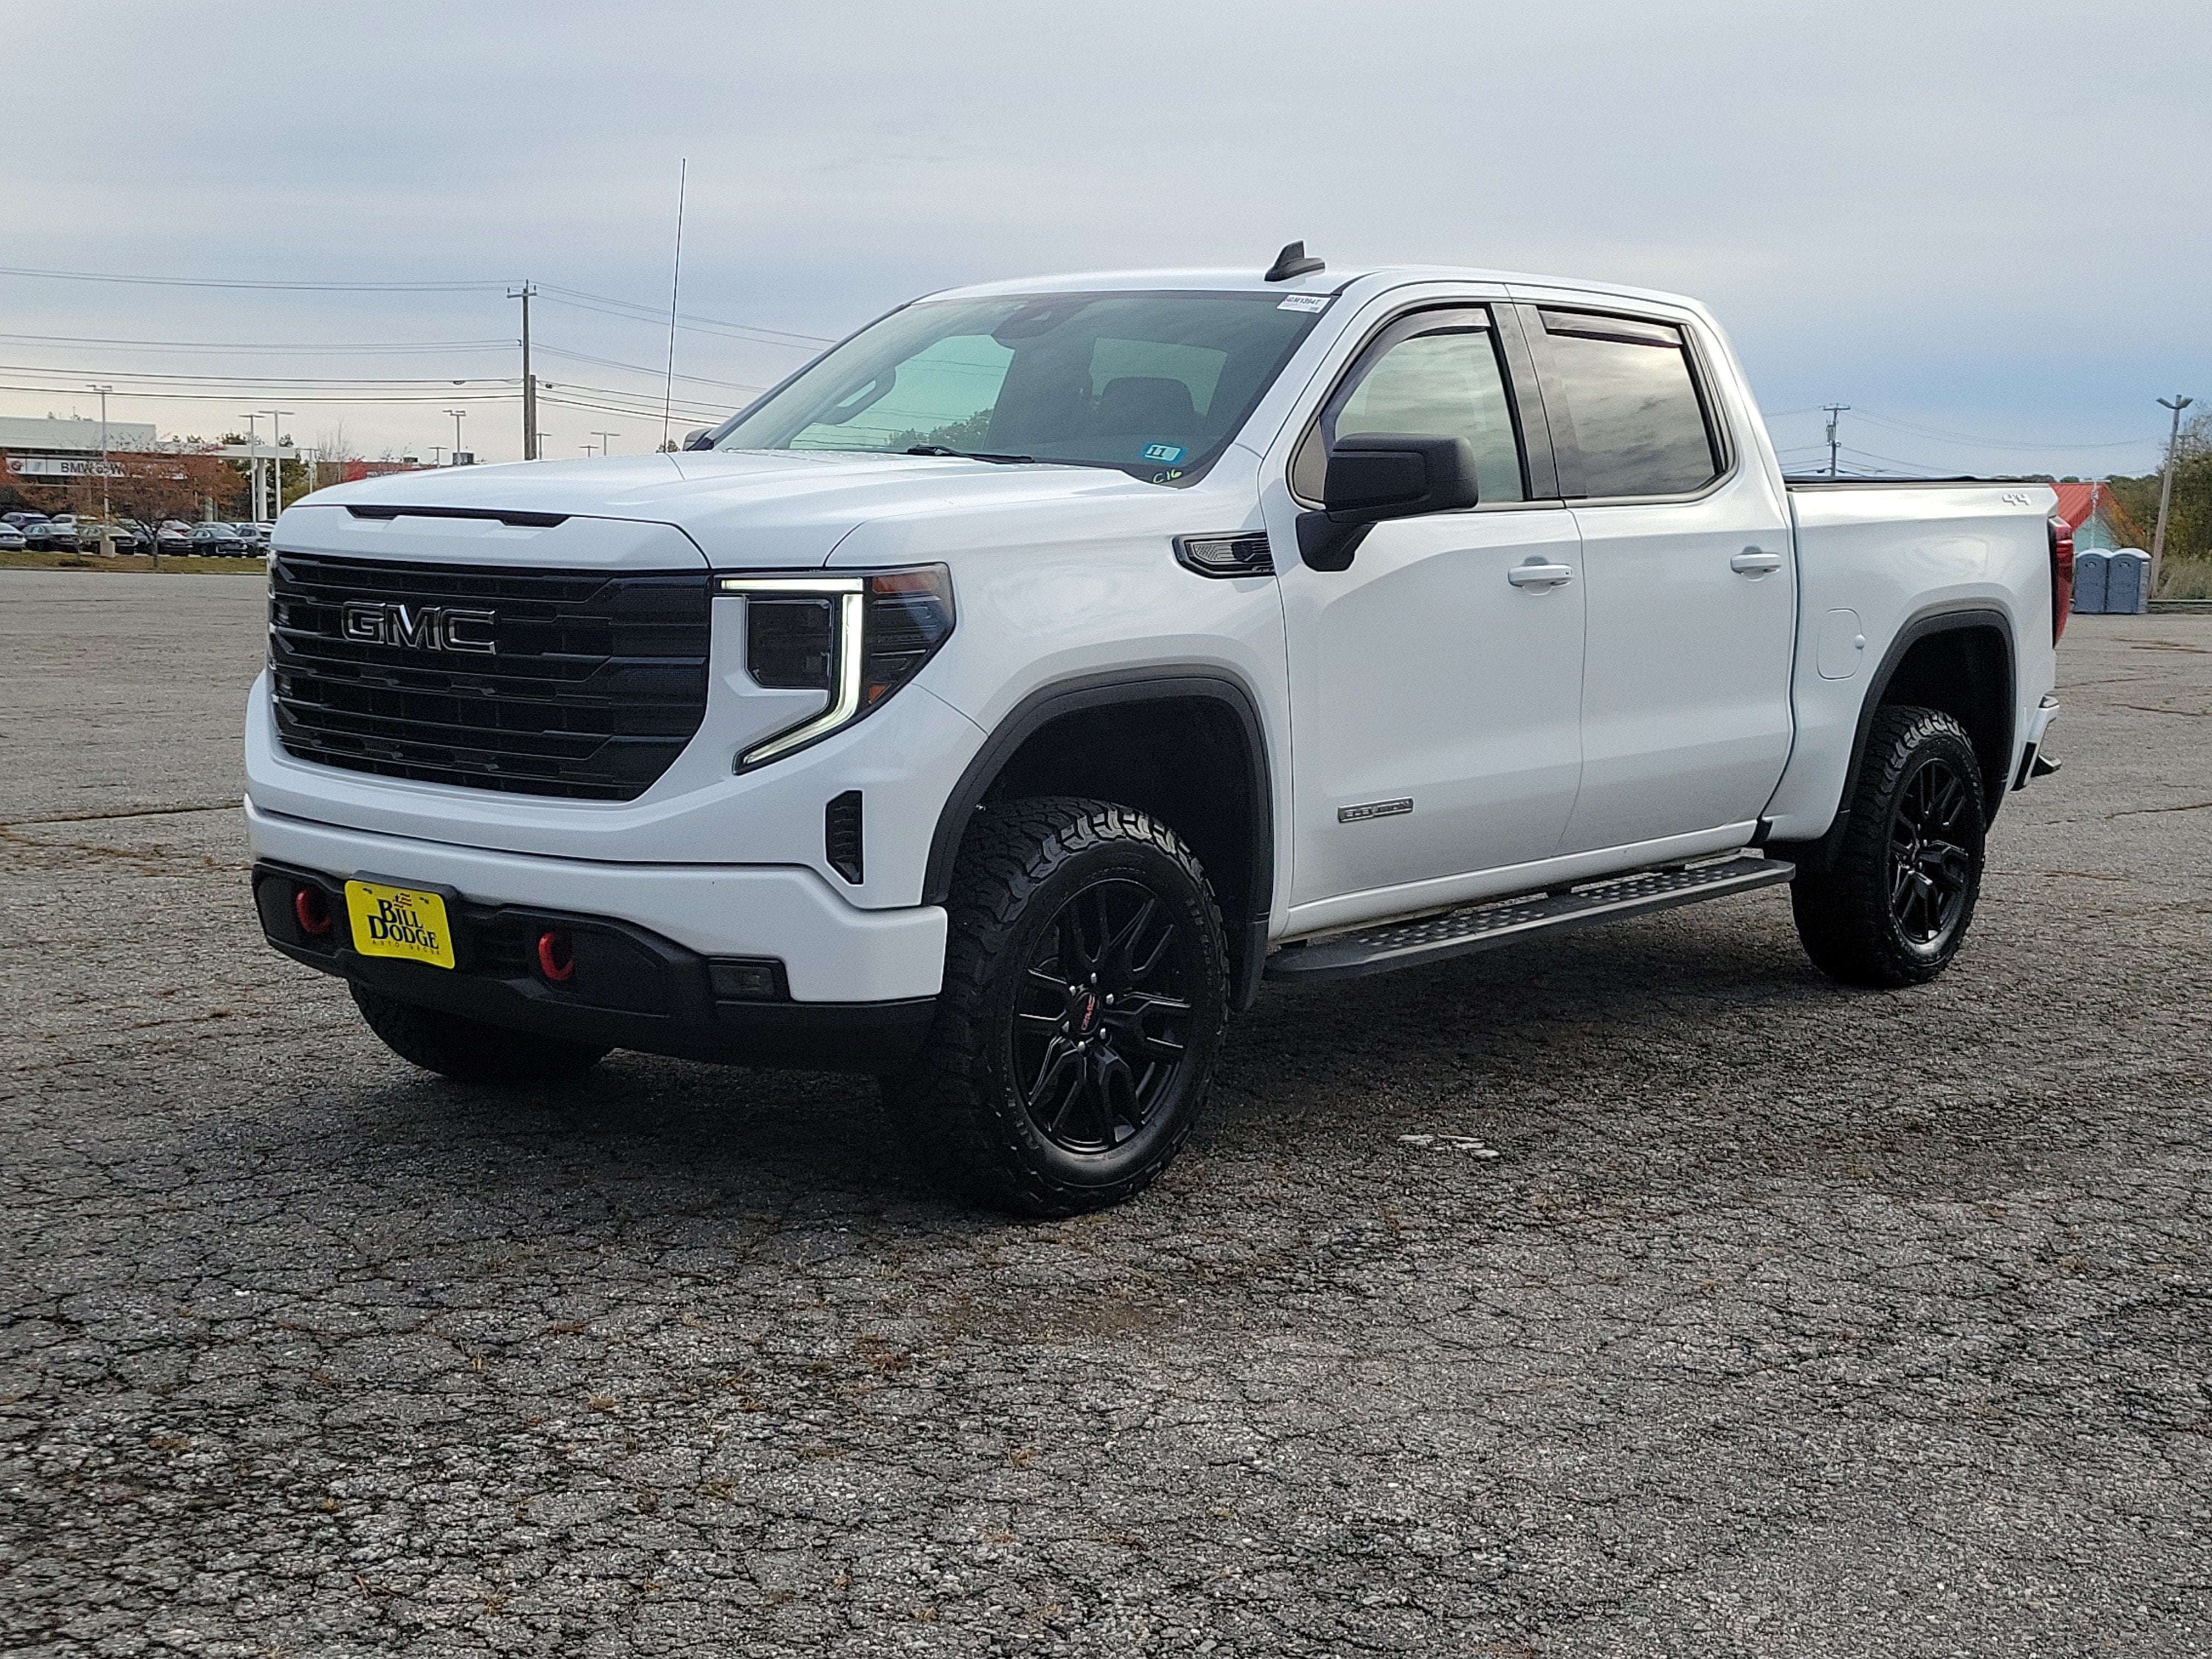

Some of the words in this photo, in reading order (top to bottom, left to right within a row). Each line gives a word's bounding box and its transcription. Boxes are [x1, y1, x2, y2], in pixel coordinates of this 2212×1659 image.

[1146, 447, 1166, 458] 11
[341, 601, 496, 654] GMC
[376, 899, 423, 929] BILL
[366, 914, 439, 949] DODGE
